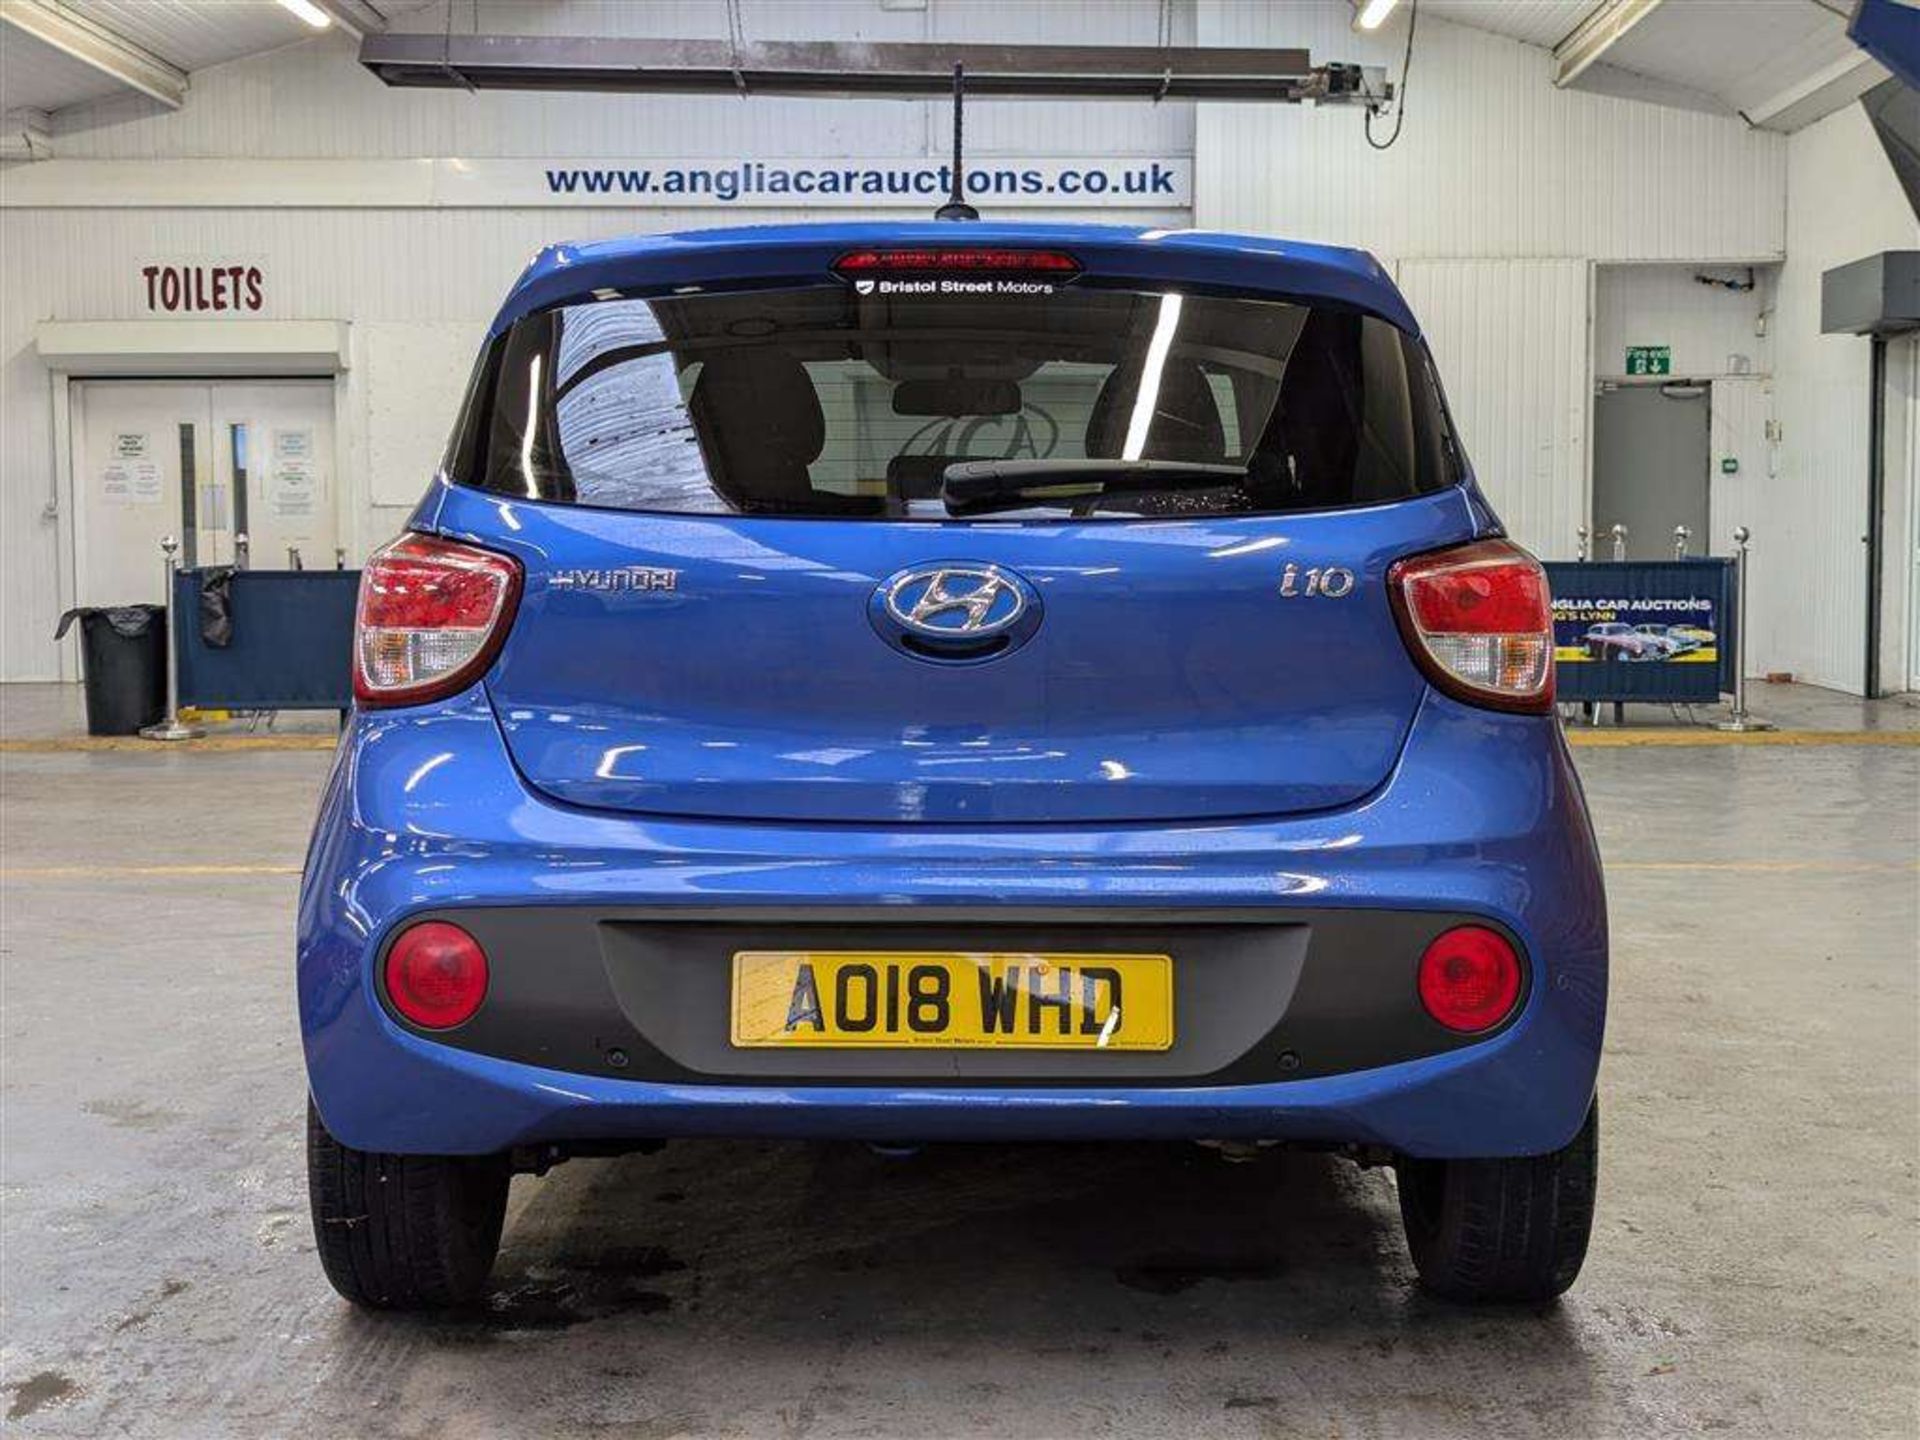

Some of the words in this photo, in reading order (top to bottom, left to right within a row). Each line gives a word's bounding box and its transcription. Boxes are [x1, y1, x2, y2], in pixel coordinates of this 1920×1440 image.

[546, 161, 1174, 200] www.angliacarauctons.co.uk
[143, 266, 263, 311] TOILETS
[879, 280, 936, 294] Bristol
[941, 280, 993, 294] Street
[997, 281, 1053, 295] Motors
[548, 569, 676, 590] HYUNDAI
[1280, 563, 1355, 597] i10
[1550, 599, 1594, 610] NGLIA
[1595, 599, 1629, 610] CAR
[1631, 599, 1712, 610] AUCTIONS
[1552, 611, 1578, 621] G'S
[1580, 611, 1616, 621] LYNN
[785, 963, 950, 1032] AO18
[978, 965, 1123, 1035] WHD
